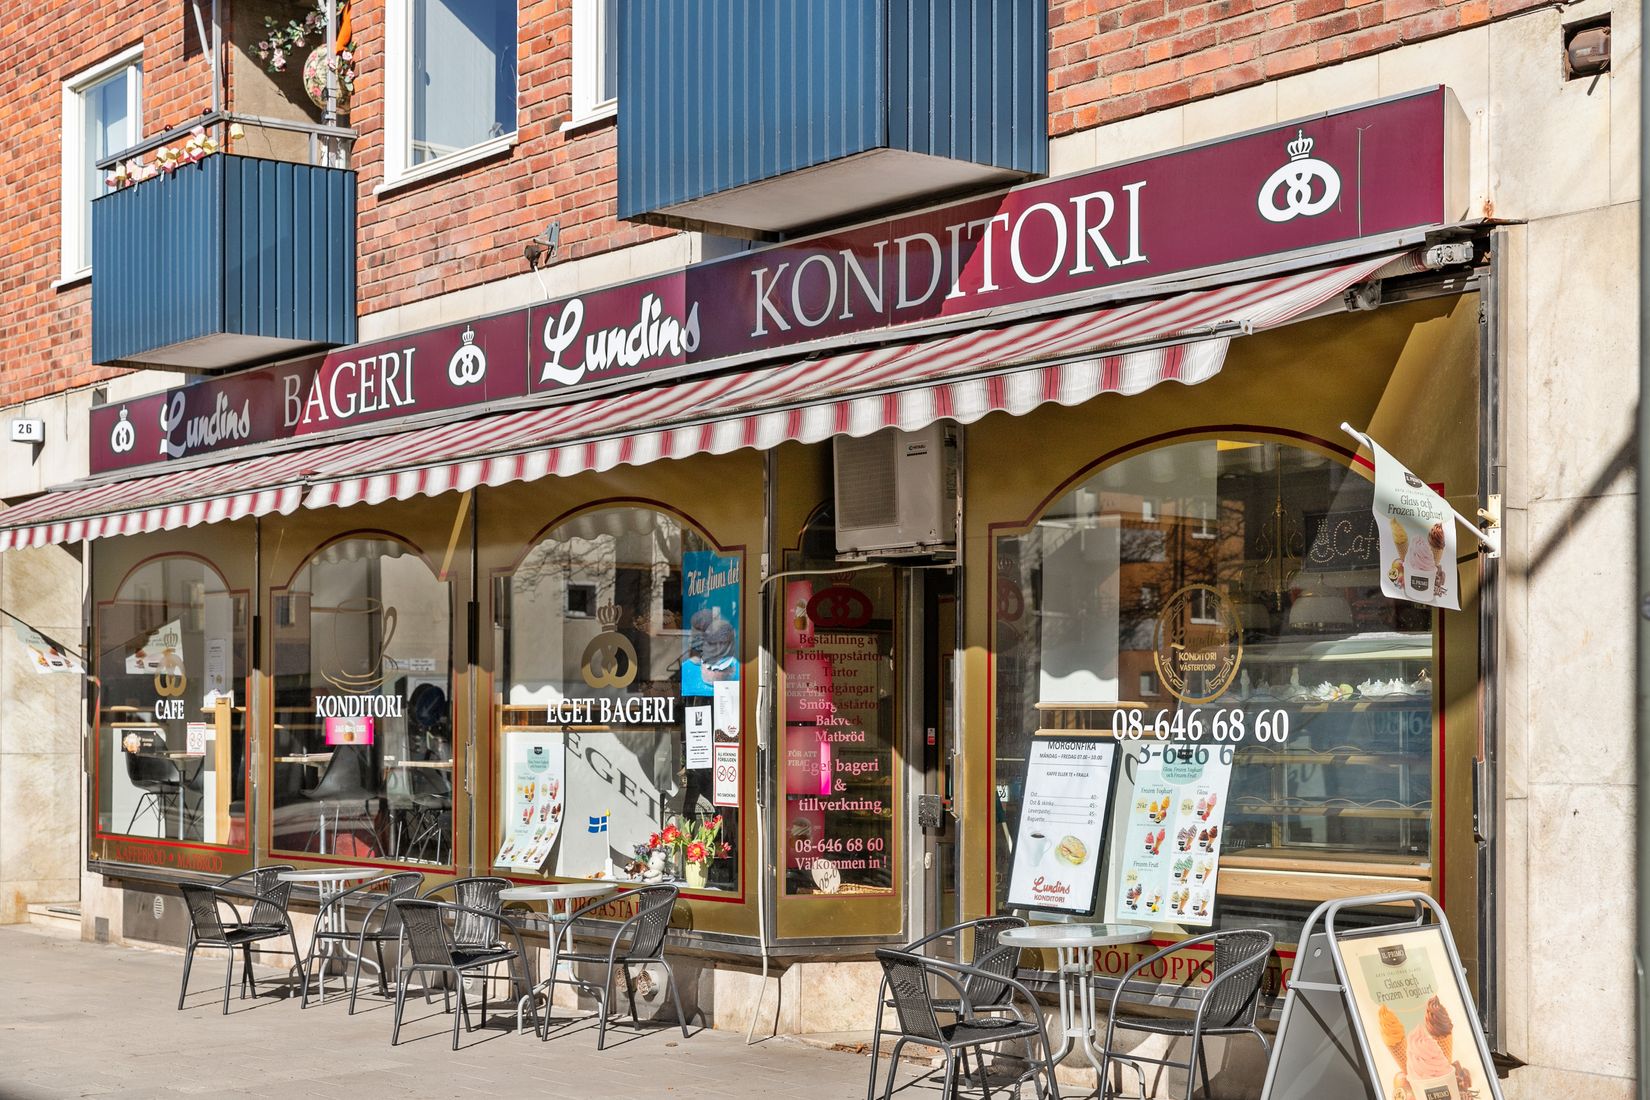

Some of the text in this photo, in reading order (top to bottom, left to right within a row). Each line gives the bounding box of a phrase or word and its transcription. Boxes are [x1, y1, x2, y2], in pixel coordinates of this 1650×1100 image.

[751, 180, 1147, 337] KONDITORI
[539, 293, 700, 385] Lundins
[283, 348, 415, 427] BAGERI
[18, 423, 32, 434] 26
[160, 391, 250, 458] Lundins
[1401, 495, 1419, 506] Glass
[1388, 504, 1414, 516] Frozen
[688, 560, 739, 598] Här finns det
[800, 634, 864, 647] Beställning
[1178, 652, 1217, 661] KONDITORI
[1180, 662, 1216, 671] VÄSTERTORP
[155, 700, 184, 719] CAFE
[315, 695, 402, 717] KONDITORI
[547, 698, 595, 723] EGET
[600, 697, 675, 723] BAGERI
[816, 715, 863, 726] Bakverk
[1111, 708, 1289, 743] 08-646 68 60
[815, 729, 865, 742] Matbröd
[1047, 742, 1097, 751] MORGONFIKA
[835, 759, 879, 775] bageri
[834, 778, 847, 791] &
[799, 798, 882, 814] tillverkning
[795, 838, 883, 853] 08-646 68 60
[115, 845, 222, 872] KAFFEBRÖD MATBRÖD
[795, 856, 865, 870] Välkommen
[869, 856, 880, 868] in
[1032, 876, 1070, 894] Lundins
[1034, 894, 1065, 903] KONDITORI
[1384, 974, 1419, 989] Glass och
[1376, 983, 1434, 1003] Frozen Yoghurt
